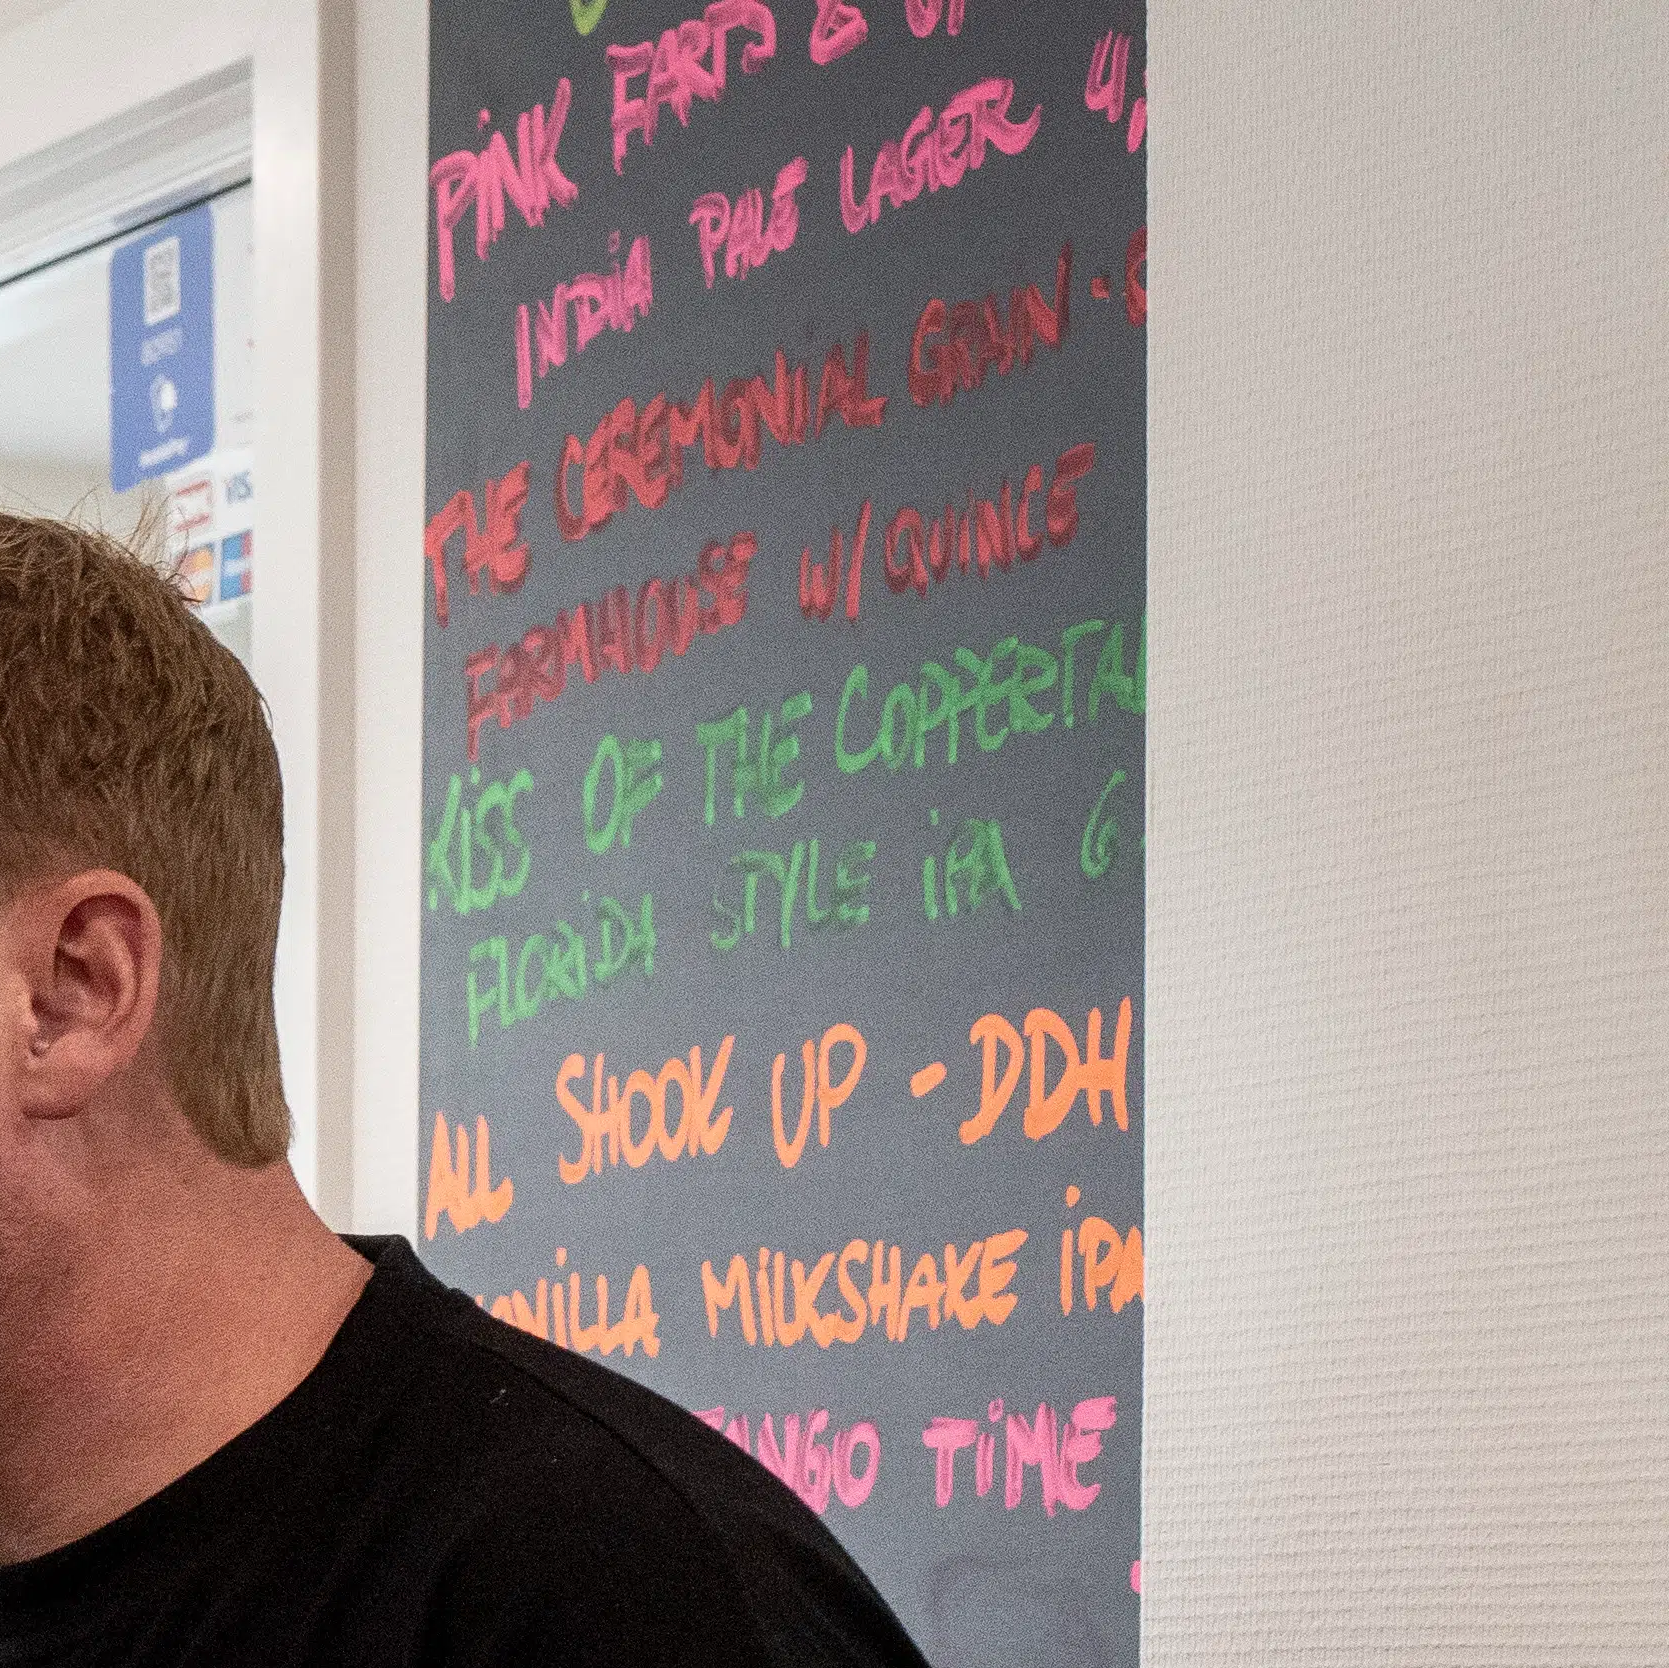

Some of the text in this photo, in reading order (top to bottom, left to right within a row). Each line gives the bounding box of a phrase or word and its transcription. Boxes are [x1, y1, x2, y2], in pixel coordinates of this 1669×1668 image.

[689, 157, 808, 290] PALE
[840, 78, 1042, 234] LAGER
[424, 461, 531, 628] THE
[556, 332, 888, 543] CEREMONIAL
[583, 734, 663, 855] OF
[696, 692, 813, 826] THE
[834, 612, 1147, 773] COPPERTA
[709, 838, 878, 950] STYLE
[425, 1110, 514, 1239] ALL
[556, 1034, 736, 1184] SHOOK
[771, 1022, 868, 1168] UP
[959, 995, 1134, 1144] DDH
